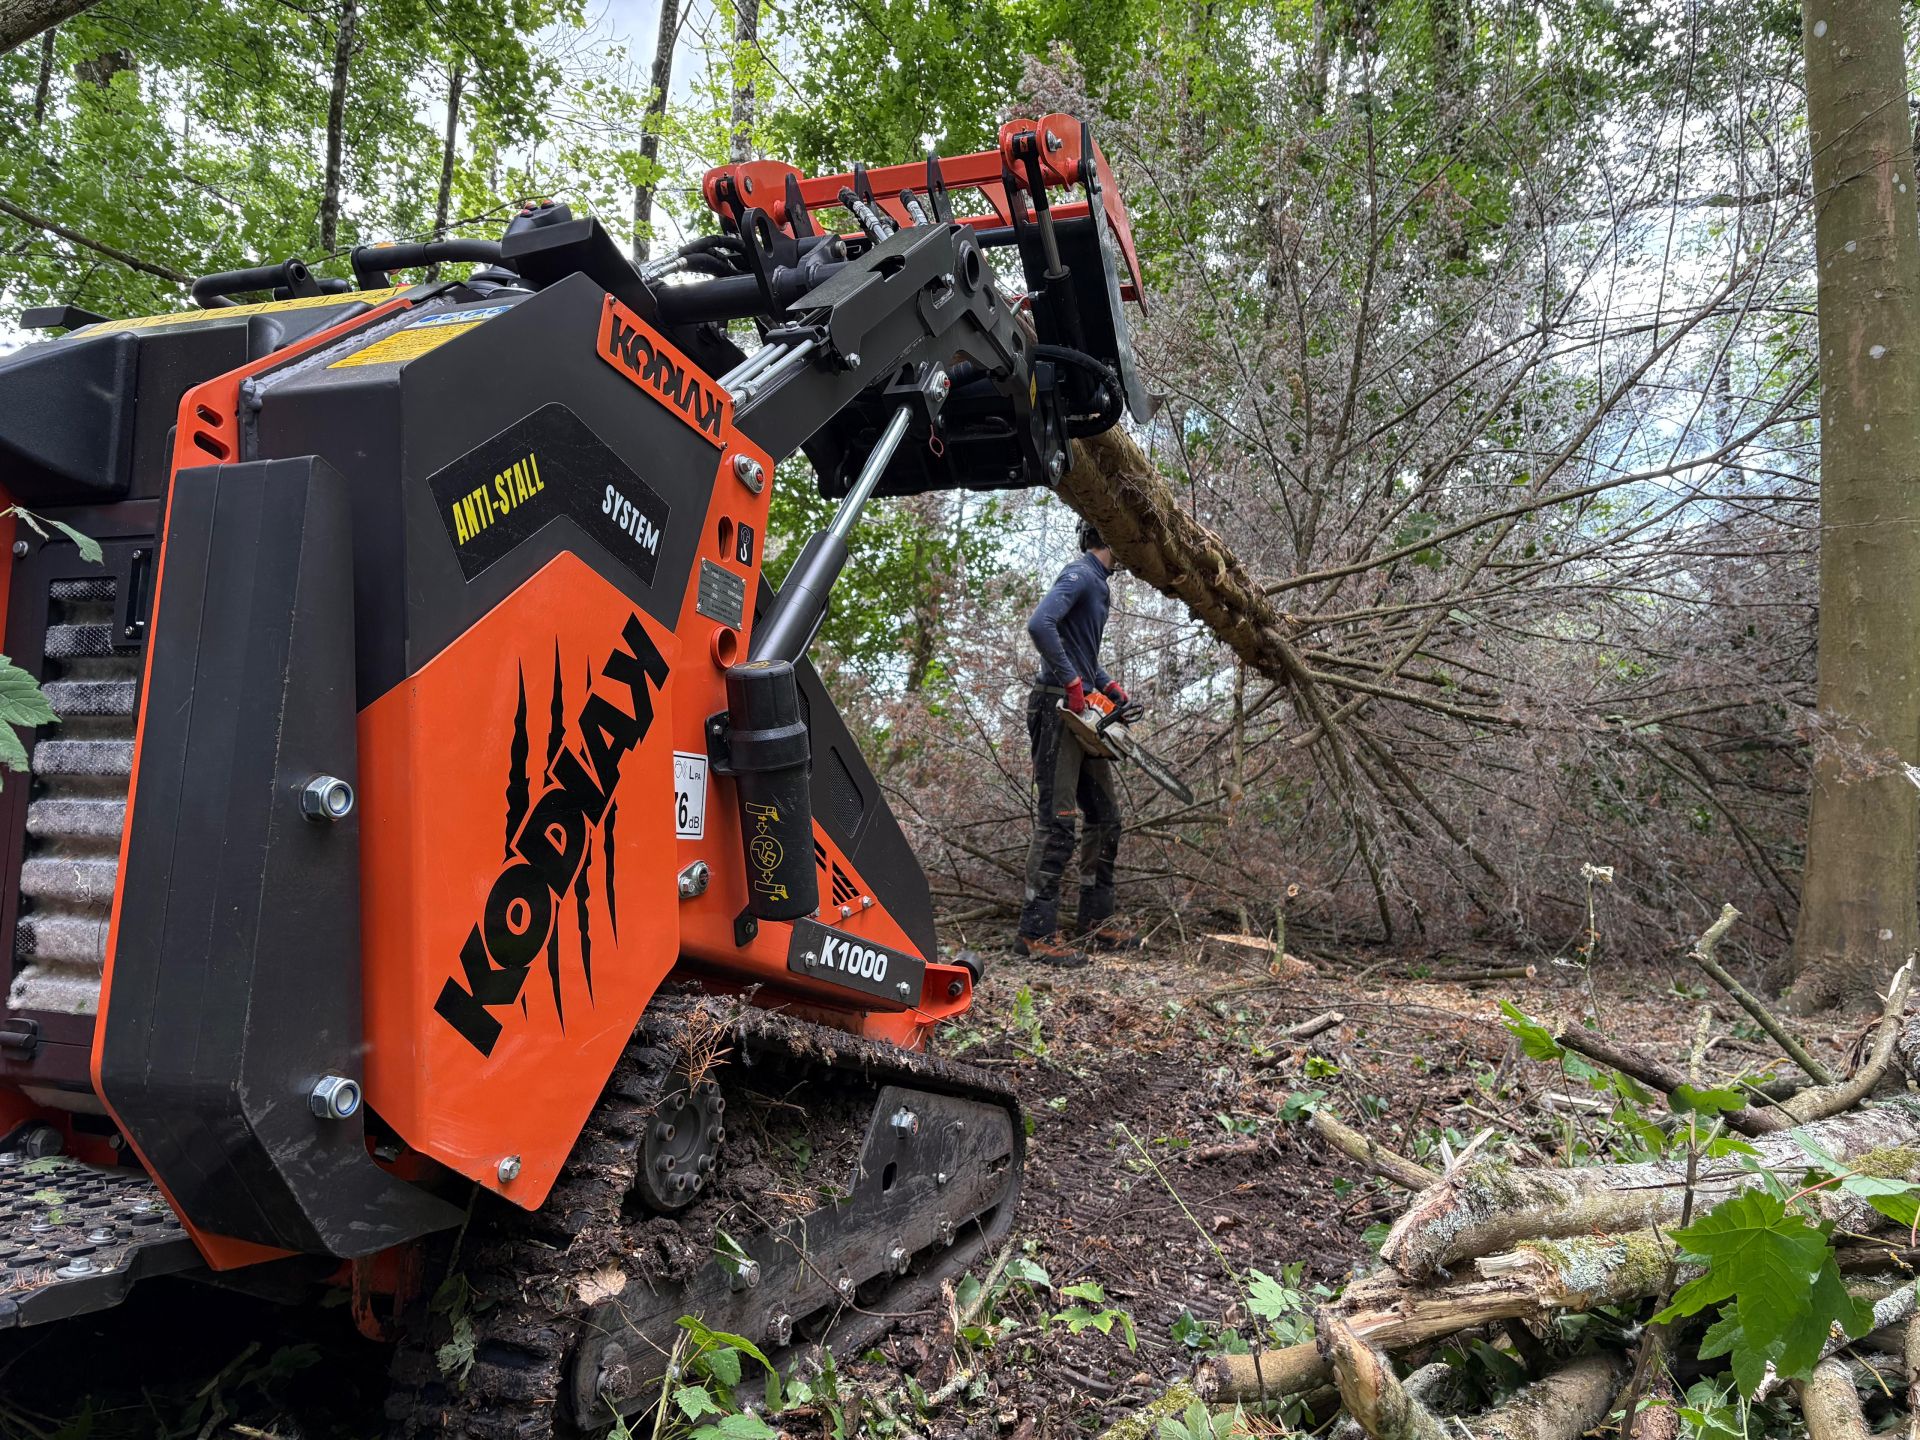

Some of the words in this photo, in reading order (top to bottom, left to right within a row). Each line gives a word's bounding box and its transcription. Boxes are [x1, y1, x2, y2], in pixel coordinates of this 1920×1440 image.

[609, 313, 724, 438] KODIAK
[452, 452, 545, 546] ANTI-STALL
[602, 484, 660, 556] SYSTEM
[433, 611, 670, 1058] KODIAK
[689, 816, 700, 829] dB
[820, 935, 888, 982] K1000
